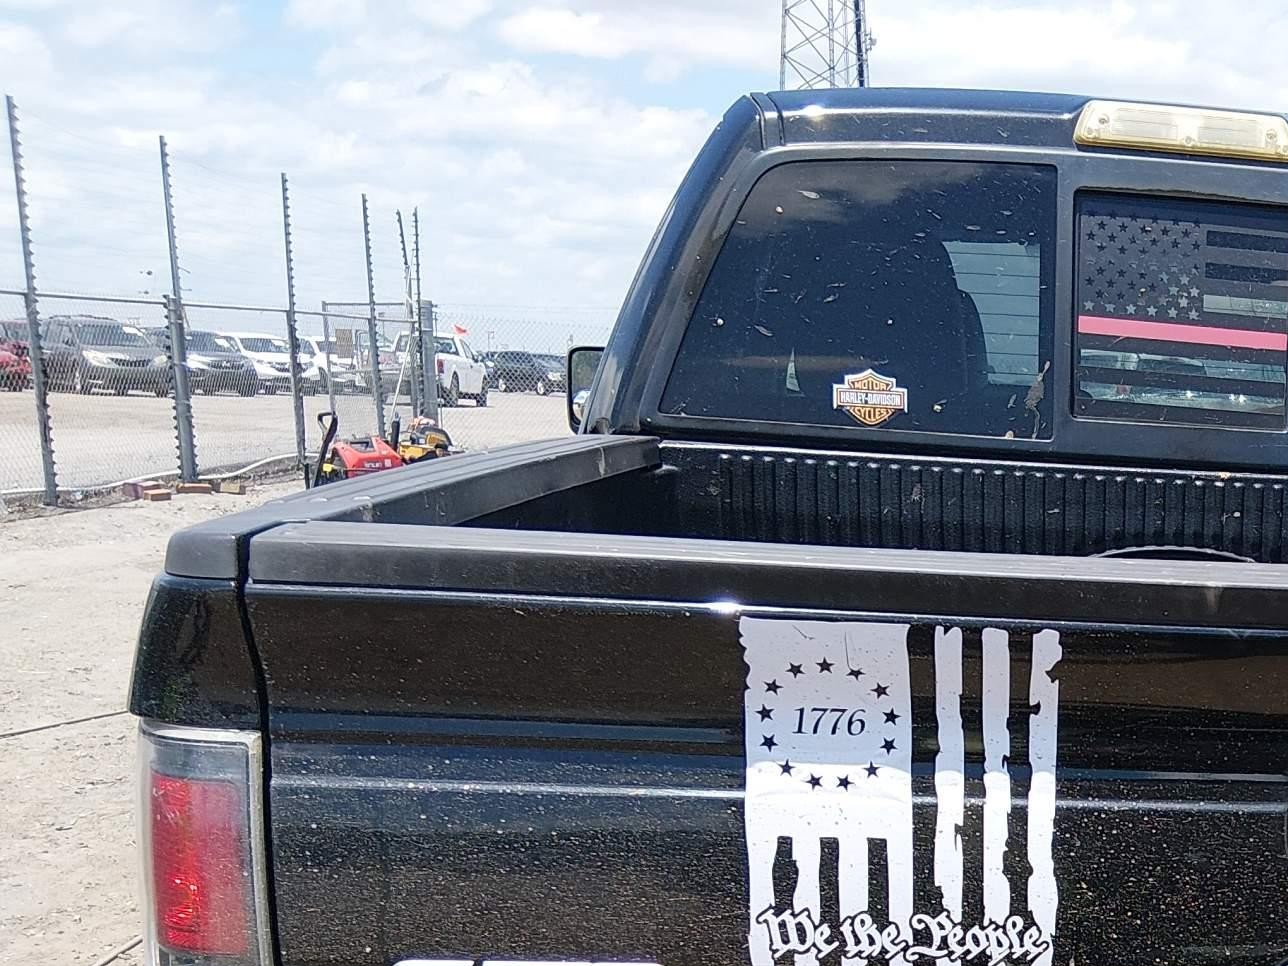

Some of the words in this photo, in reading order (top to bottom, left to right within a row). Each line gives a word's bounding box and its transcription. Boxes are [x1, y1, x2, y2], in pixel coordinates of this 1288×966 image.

[854, 378, 887, 390] MOTOR
[840, 391, 901, 406] HARLEY-DAVIDSON
[855, 407, 887, 421] CYCLES
[792, 707, 866, 736] 1776
[756, 907, 840, 959] We
[839, 911, 906, 958] the
